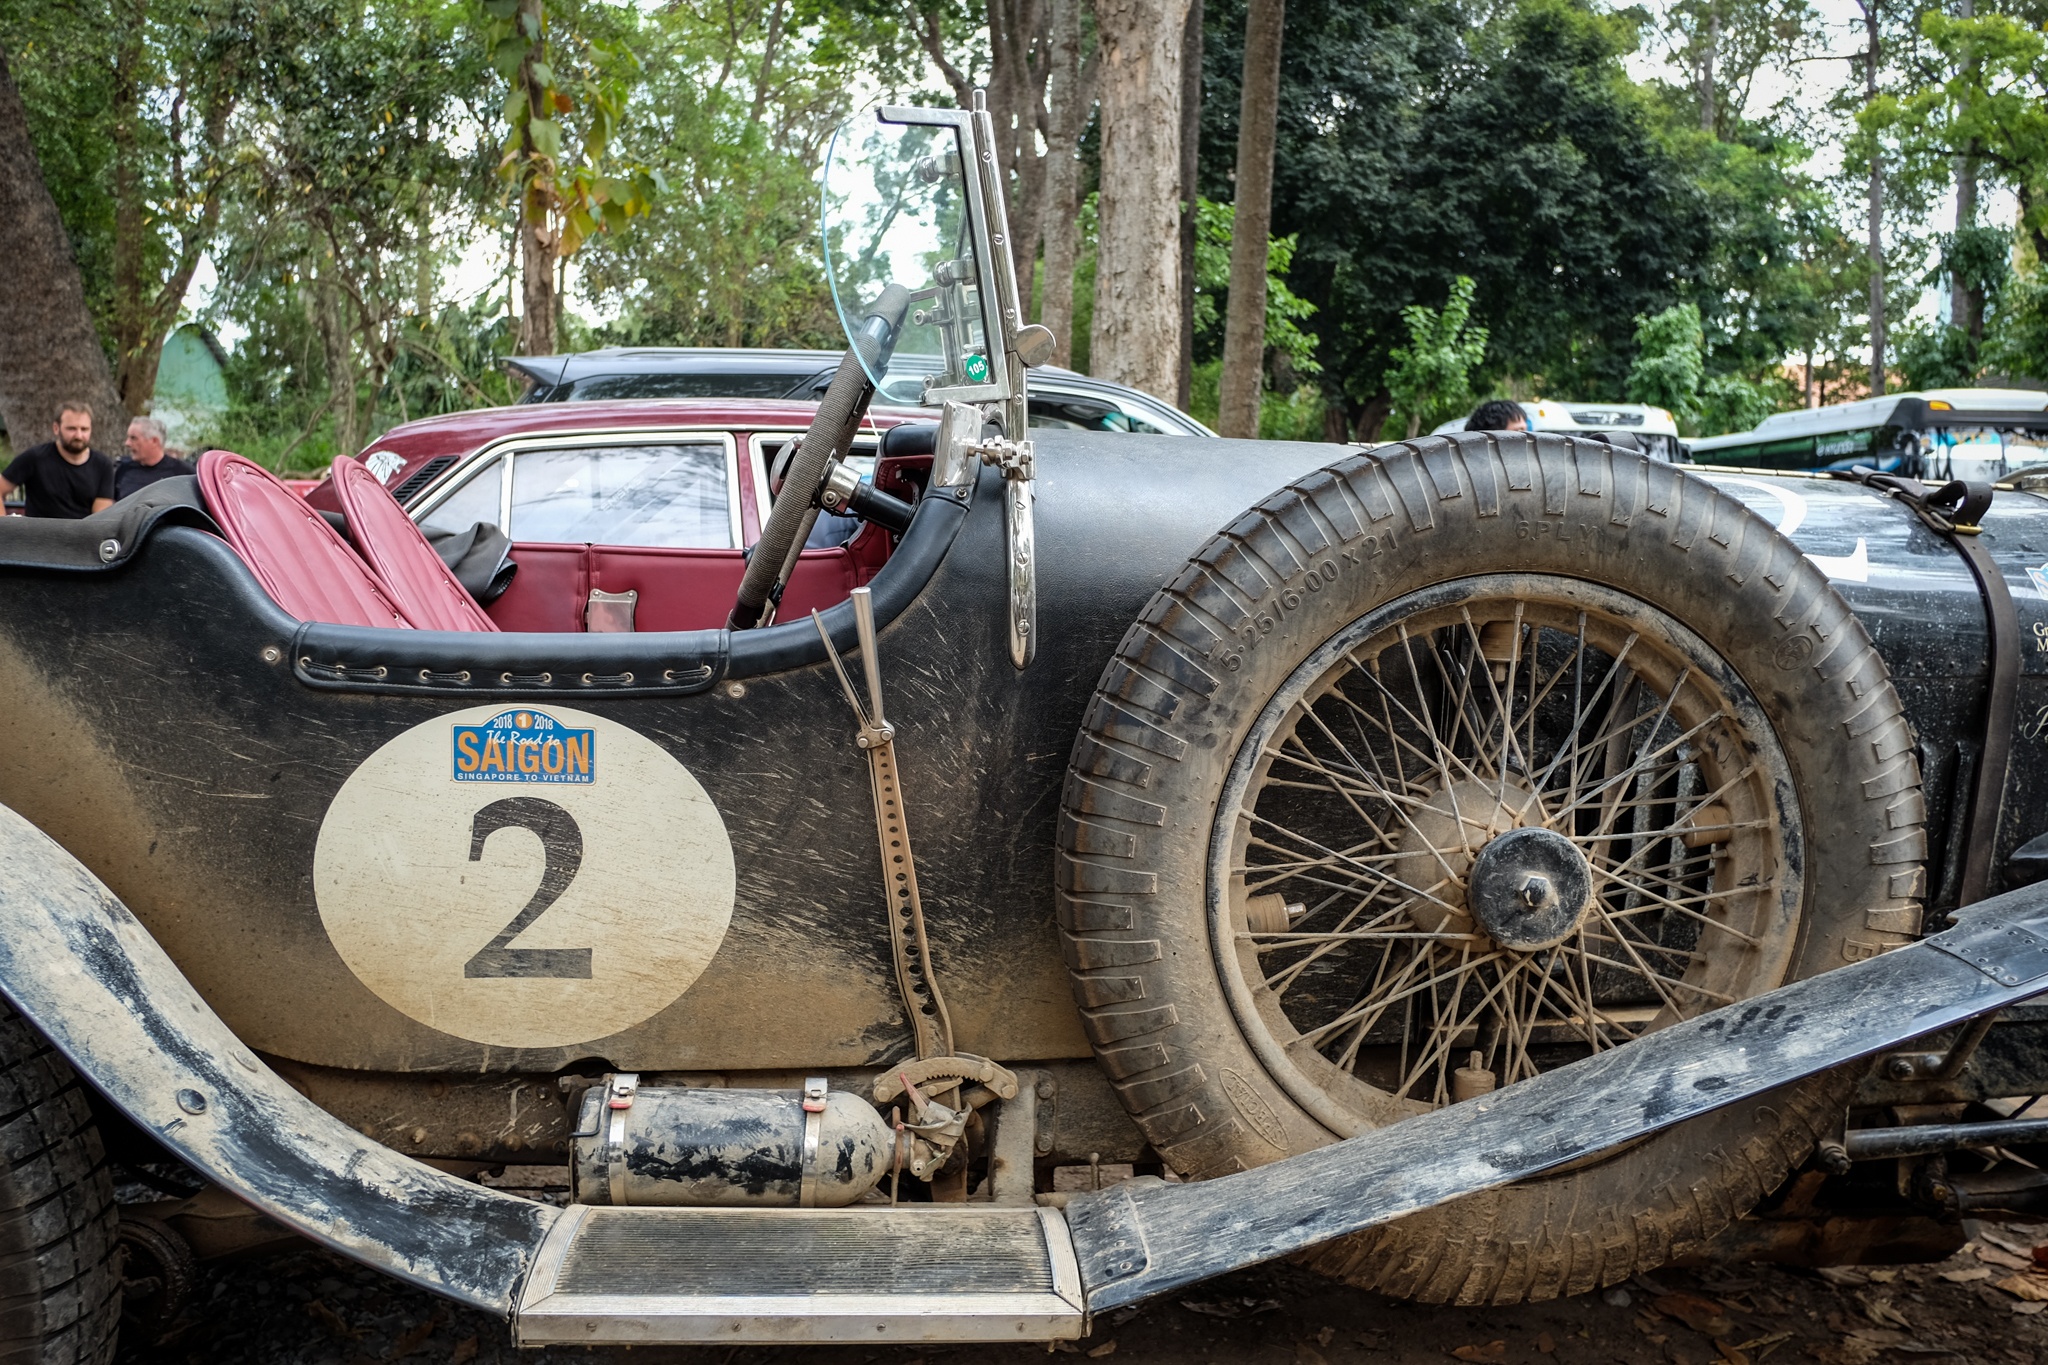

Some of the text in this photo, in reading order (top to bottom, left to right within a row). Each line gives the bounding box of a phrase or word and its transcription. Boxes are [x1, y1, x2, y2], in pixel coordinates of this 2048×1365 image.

[968, 360, 985, 376] 105
[493, 713, 554, 730] 2018 1 2018
[486, 729, 561, 746] The Road to
[457, 730, 590, 774] SAIGON
[457, 772, 590, 783] SINGAPORE TO VIETNAM
[464, 796, 593, 979] 2
